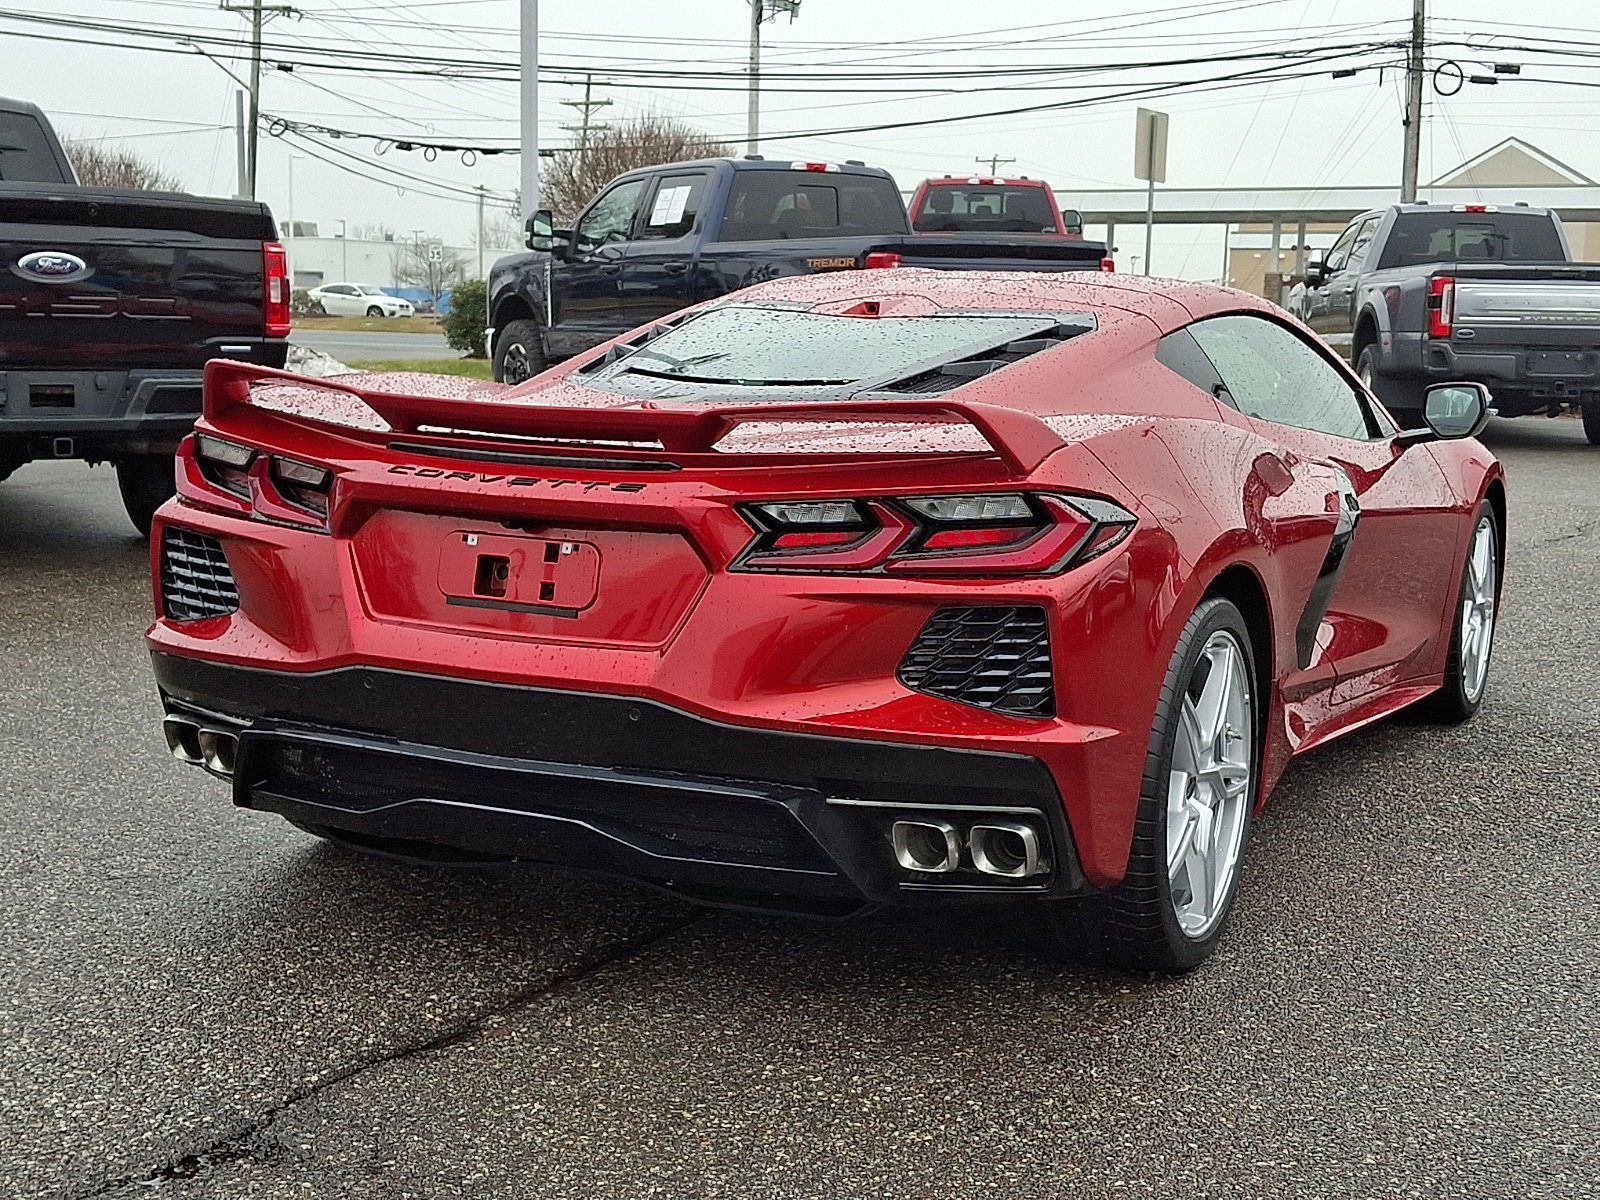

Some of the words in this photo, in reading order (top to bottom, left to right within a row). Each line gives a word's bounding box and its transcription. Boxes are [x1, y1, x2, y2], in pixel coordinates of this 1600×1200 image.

[35, 256, 71, 273] Ford
[807, 257, 856, 268] TREMOR
[387, 465, 648, 493] CORVETTE
